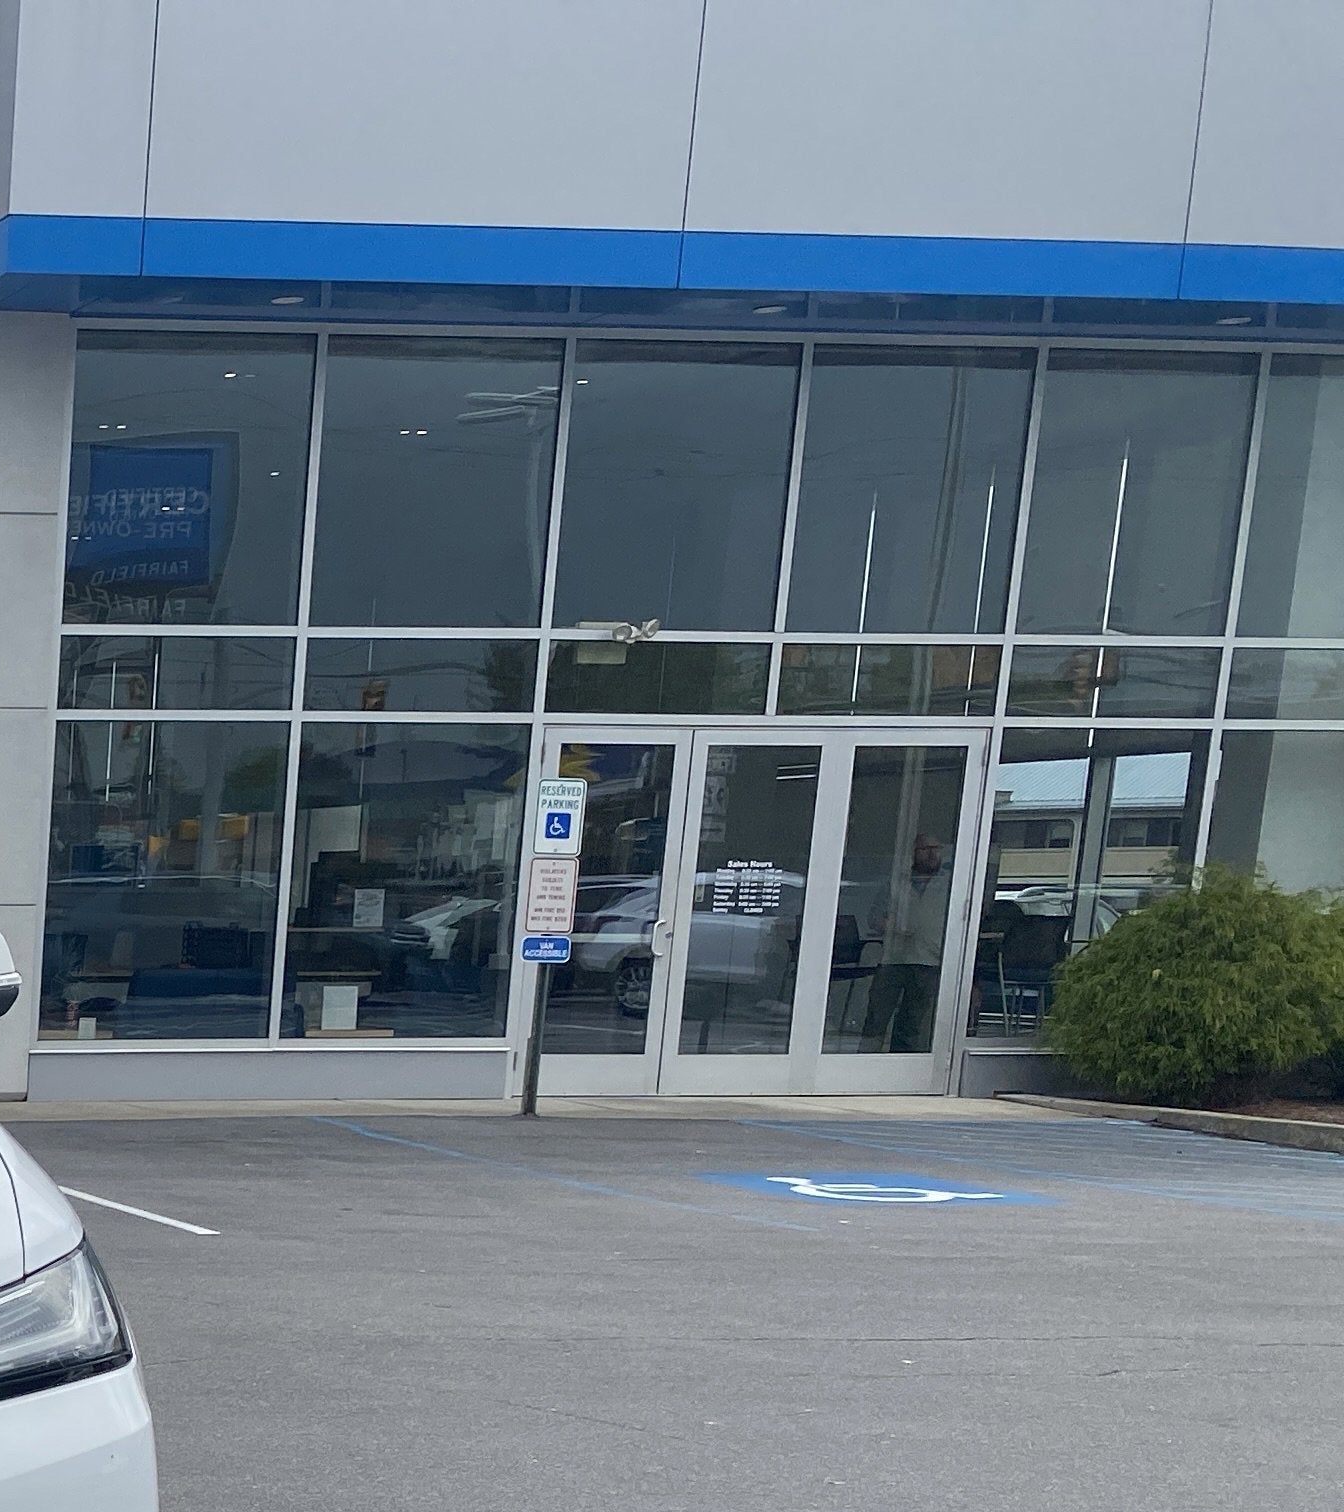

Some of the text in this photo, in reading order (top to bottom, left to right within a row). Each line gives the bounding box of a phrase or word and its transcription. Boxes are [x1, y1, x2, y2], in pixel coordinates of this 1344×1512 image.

[541, 785, 582, 797] RESERVED
[541, 799, 580, 810] PARKING
[539, 941, 554, 950] VAN
[524, 949, 568, 958] ACCESSIBLE
